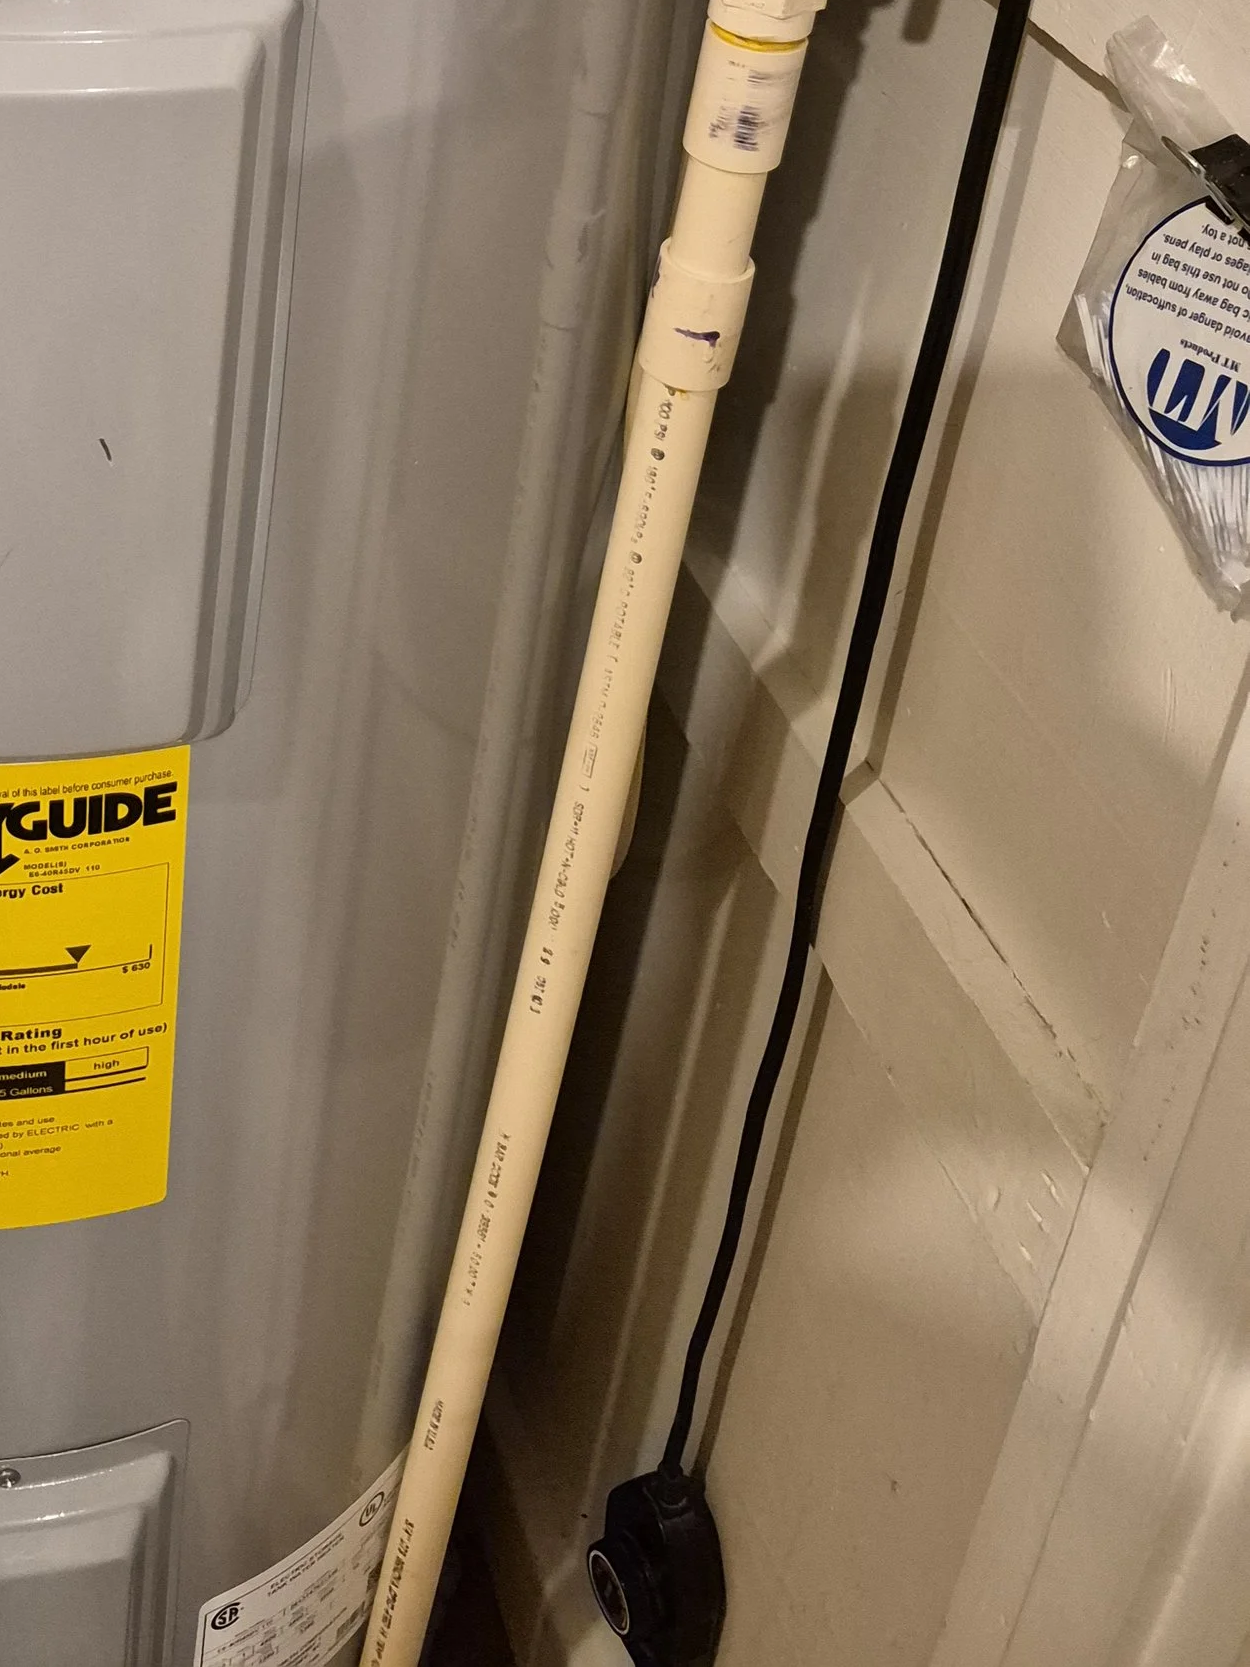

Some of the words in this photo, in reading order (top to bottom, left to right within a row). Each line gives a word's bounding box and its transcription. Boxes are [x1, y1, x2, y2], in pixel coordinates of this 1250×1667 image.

[1201, 223, 1218, 239] toy.
[1163, 233, 1189, 249] pens.
[1228, 236, 1245, 248] not
[1151, 252, 1161, 264] in
[1189, 244, 1212, 257] play
[1212, 252, 1222, 262] or
[1163, 256, 1181, 269] bag
[1137, 269, 1167, 287] babies
[1181, 263, 1201, 279] this
[1202, 272, 1221, 284] use
[1169, 280, 1192, 296] from
[1223, 278, 1241, 292] not
[1125, 284, 1177, 313] suffocation,
[1192, 289, 1219, 306] away
[1176, 306, 1188, 318] of
[1220, 298, 1241, 317] bag
[1189, 312, 1224, 332] danger
[1180, 338, 1221, 363] Products
[1220, 356, 1242, 373] MT
[12, 788, 20, 797] of
[23, 788, 37, 797] this
[40, 786, 60, 795] label
[63, 783, 89, 793] before
[92, 777, 132, 790] consumer
[134, 770, 173, 785] purchase.
[32, 883, 63, 895] Cost
[131, 962, 151, 972] 630
[1, 1028, 62, 1042] Rating
[7, 1045, 19, 1054] in
[24, 1044, 46, 1053] the
[51, 1039, 78, 1050] first
[83, 1035, 116, 1046] hour
[120, 1029, 134, 1040] of
[138, 1023, 167, 1036] use)
[94, 1059, 120, 1070] high
[10, 1083, 53, 1097] Gallons
